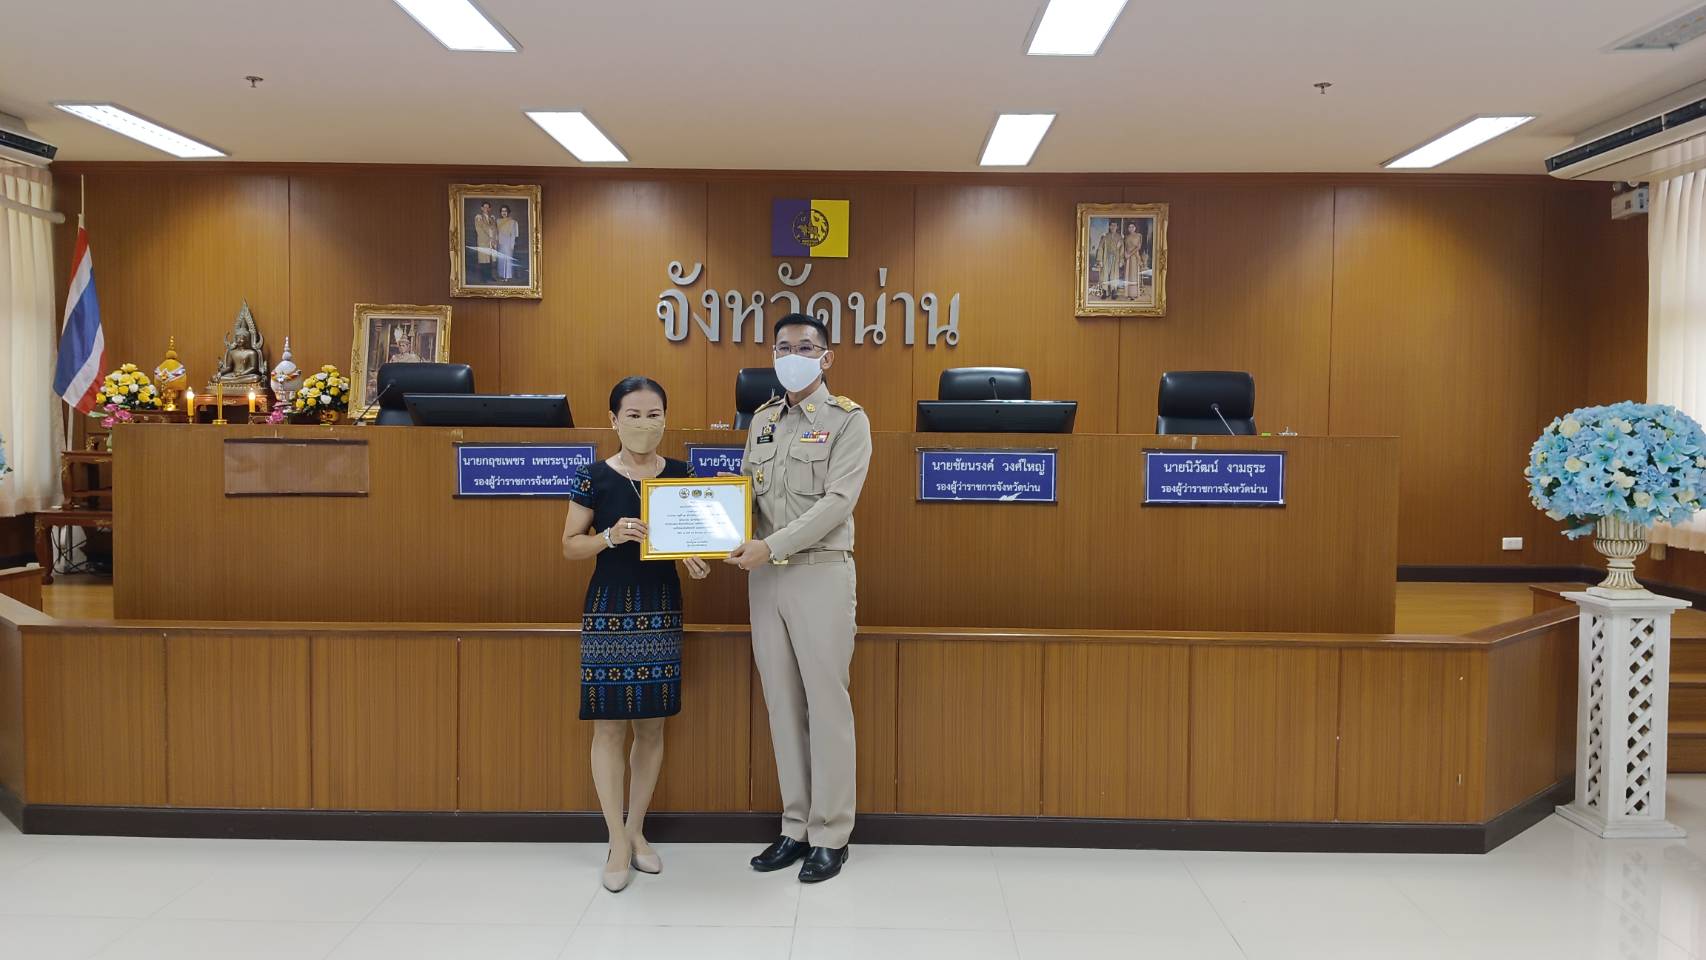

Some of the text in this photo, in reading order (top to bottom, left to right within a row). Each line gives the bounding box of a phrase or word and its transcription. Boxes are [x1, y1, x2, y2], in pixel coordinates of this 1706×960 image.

[699, 454, 743, 471] นายวิบูร
[932, 458, 995, 472] นายชัยนรงค์
[1163, 459, 1266, 477] นายนิวัฒน์ งามธุระ
[474, 475, 574, 489] รองผู้ว่าราชการจังหวัดน่า
[936, 480, 1041, 494] รองผู้ว่าราชการจังหวัดน่าน
[1161, 482, 1268, 496] รองผู้ว่าราชการจังหวัดน่าน
